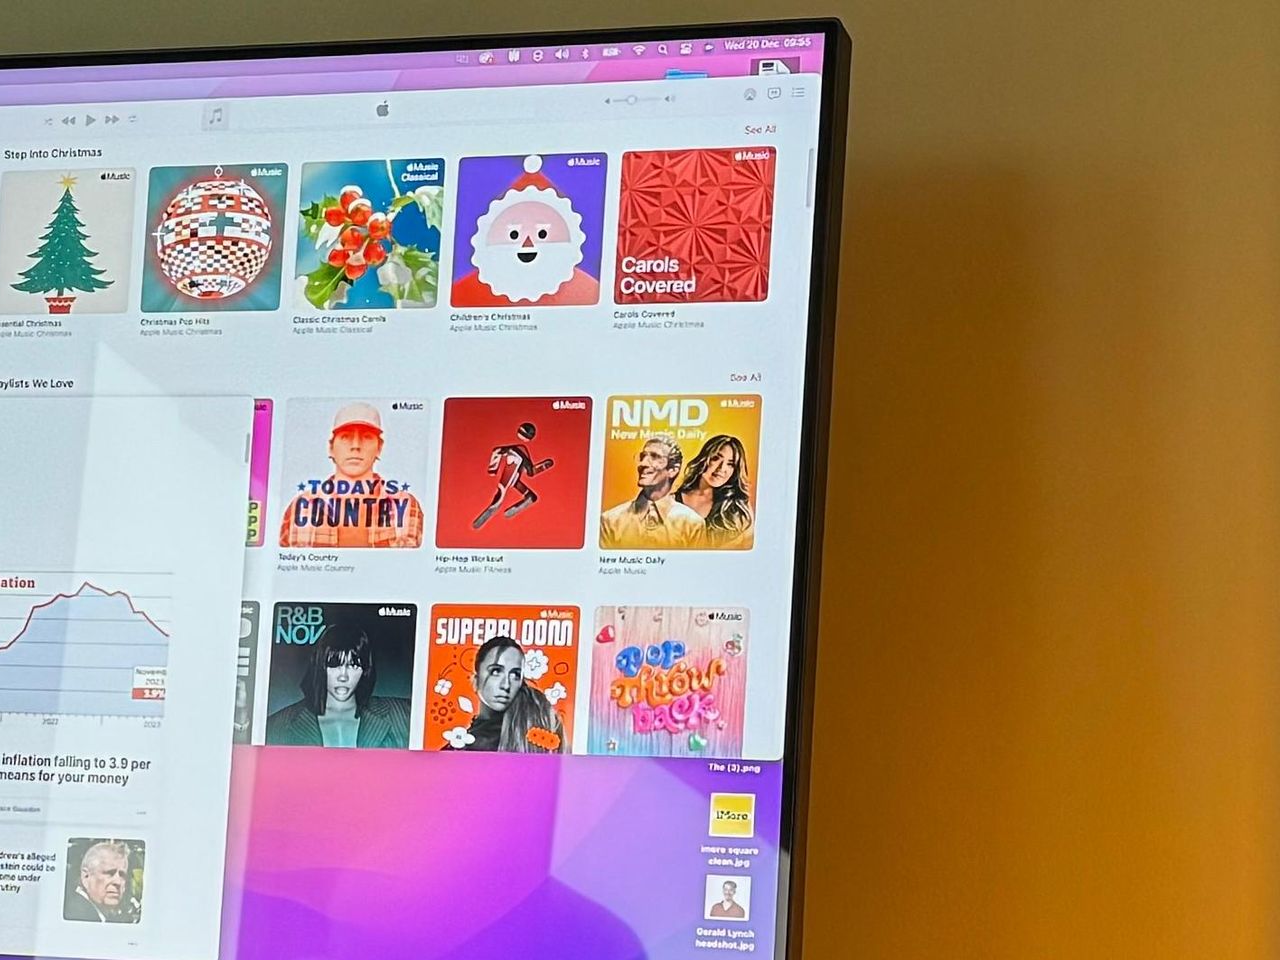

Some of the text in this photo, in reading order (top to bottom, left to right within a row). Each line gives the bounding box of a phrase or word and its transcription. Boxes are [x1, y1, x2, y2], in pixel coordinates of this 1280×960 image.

[725, 40, 745, 49] Wed
[747, 40, 759, 48] 20
[761, 40, 780, 48] Dec
[4, 148, 102, 160] Step Into Christmas
[575, 158, 600, 166] Music
[414, 163, 439, 172] Music
[107, 172, 130, 180] Music
[258, 168, 282, 177] Music
[401, 172, 438, 182] Classical
[621, 256, 679, 274] Carols
[620, 276, 696, 295] Covered
[613, 310, 675, 319] Carols Covered
[32, 378, 48, 388] We
[50, 378, 74, 388] Love
[400, 402, 423, 410] Music
[560, 401, 586, 410] Music
[728, 400, 755, 408] Music
[612, 400, 709, 427] NMD
[611, 429, 637, 440] New
[677, 429, 708, 441] Daily
[307, 479, 400, 495] TODAY'S
[294, 498, 409, 528] COUNTRY
[278, 553, 338, 562] Today's Country
[600, 556, 665, 565] New Music Daily
[277, 606, 323, 625] R&B
[716, 612, 742, 621] Music
[2, 753, 51, 767] inflation
[53, 756, 91, 770] falling
[94, 757, 106, 768] to
[109, 757, 128, 769] 3.9
[131, 759, 151, 771] per
[38, 769, 56, 782] for
[58, 771, 85, 784] your
[87, 773, 129, 786] money
[27, 852, 56, 862] alleged
[21, 863, 43, 872] could
[46, 864, 55, 872] be
[18, 874, 41, 882] under
[696, 927, 754, 939] Gerald Lynch
